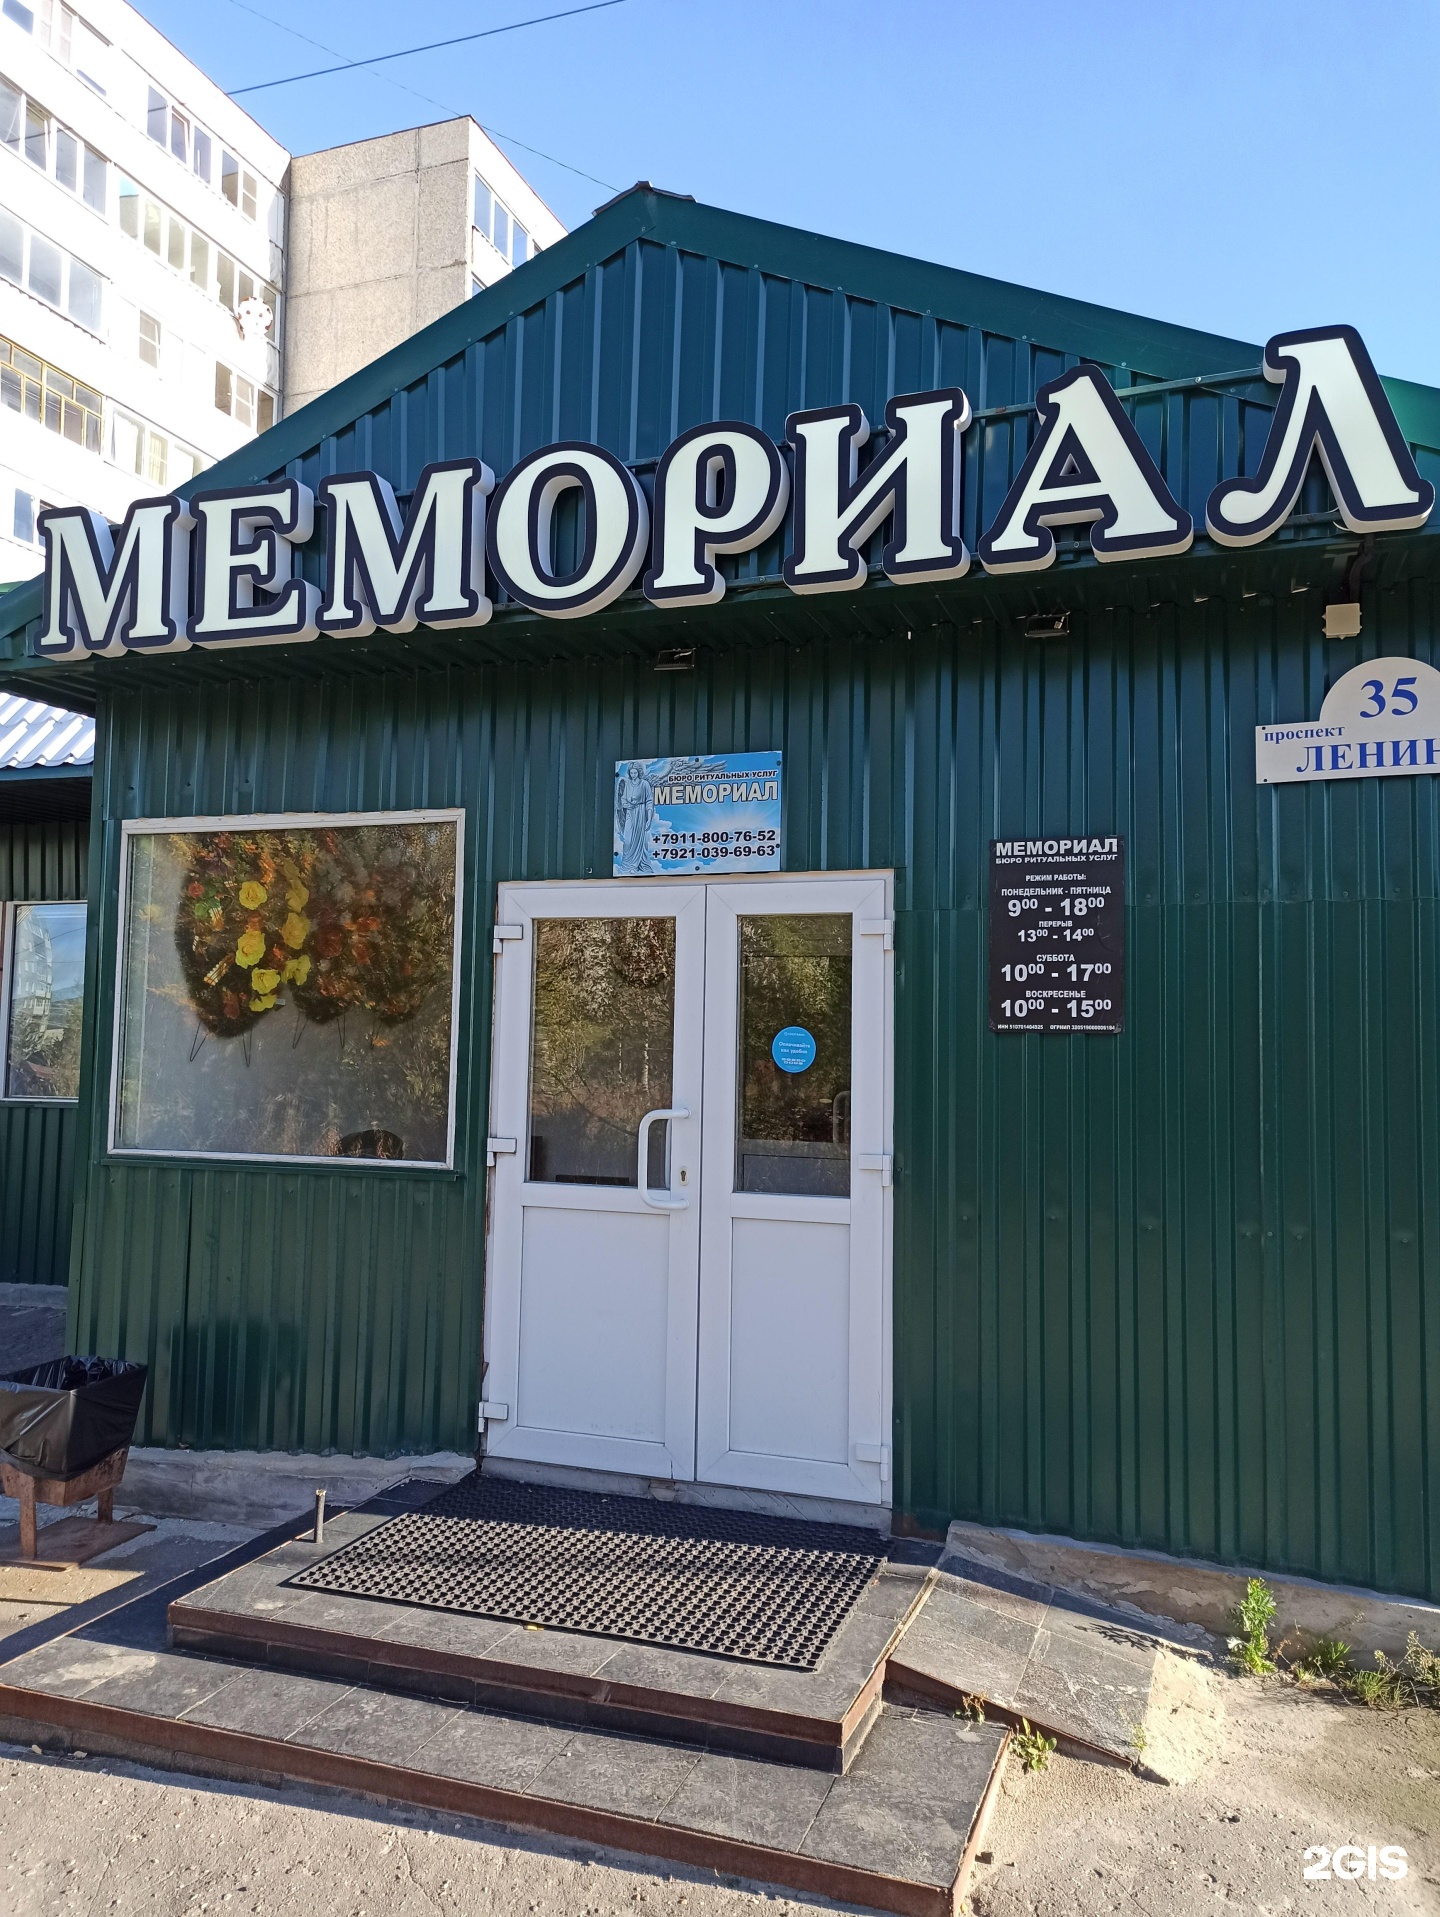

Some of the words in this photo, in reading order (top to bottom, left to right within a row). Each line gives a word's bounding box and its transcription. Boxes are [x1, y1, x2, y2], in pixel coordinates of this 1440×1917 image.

[35, 325, 1434, 656] МЕМОРИАЛ
[1359, 677, 1419, 718] 35
[1264, 726, 1345, 744] проспект
[668, 774, 693, 782] БЮРО
[694, 771, 750, 782] РИТУАЛЬНЫХ
[752, 770, 778, 779] УСЛУГ
[653, 780, 779, 805] МЕМОРИАЛ
[652, 830, 776, 844] +7911-800-76-52
[652, 845, 776, 859] +7921-039-69-63
[996, 838, 1118, 856] МЕМОРИАЛ
[1024, 855, 1087, 863] РИТУАЛЬНЫХ
[1053, 873, 1087, 881] РАБОТЫ:
[1001, 887, 1063, 897] ПОНЕДЕЛЬНИК
[1070, 886, 1112, 895] ПЯТНИЦА
[1036, 954, 1075, 962] СУББОТА
[1025, 990, 1087, 998] ВОСКРЕСЕНЬЕ
